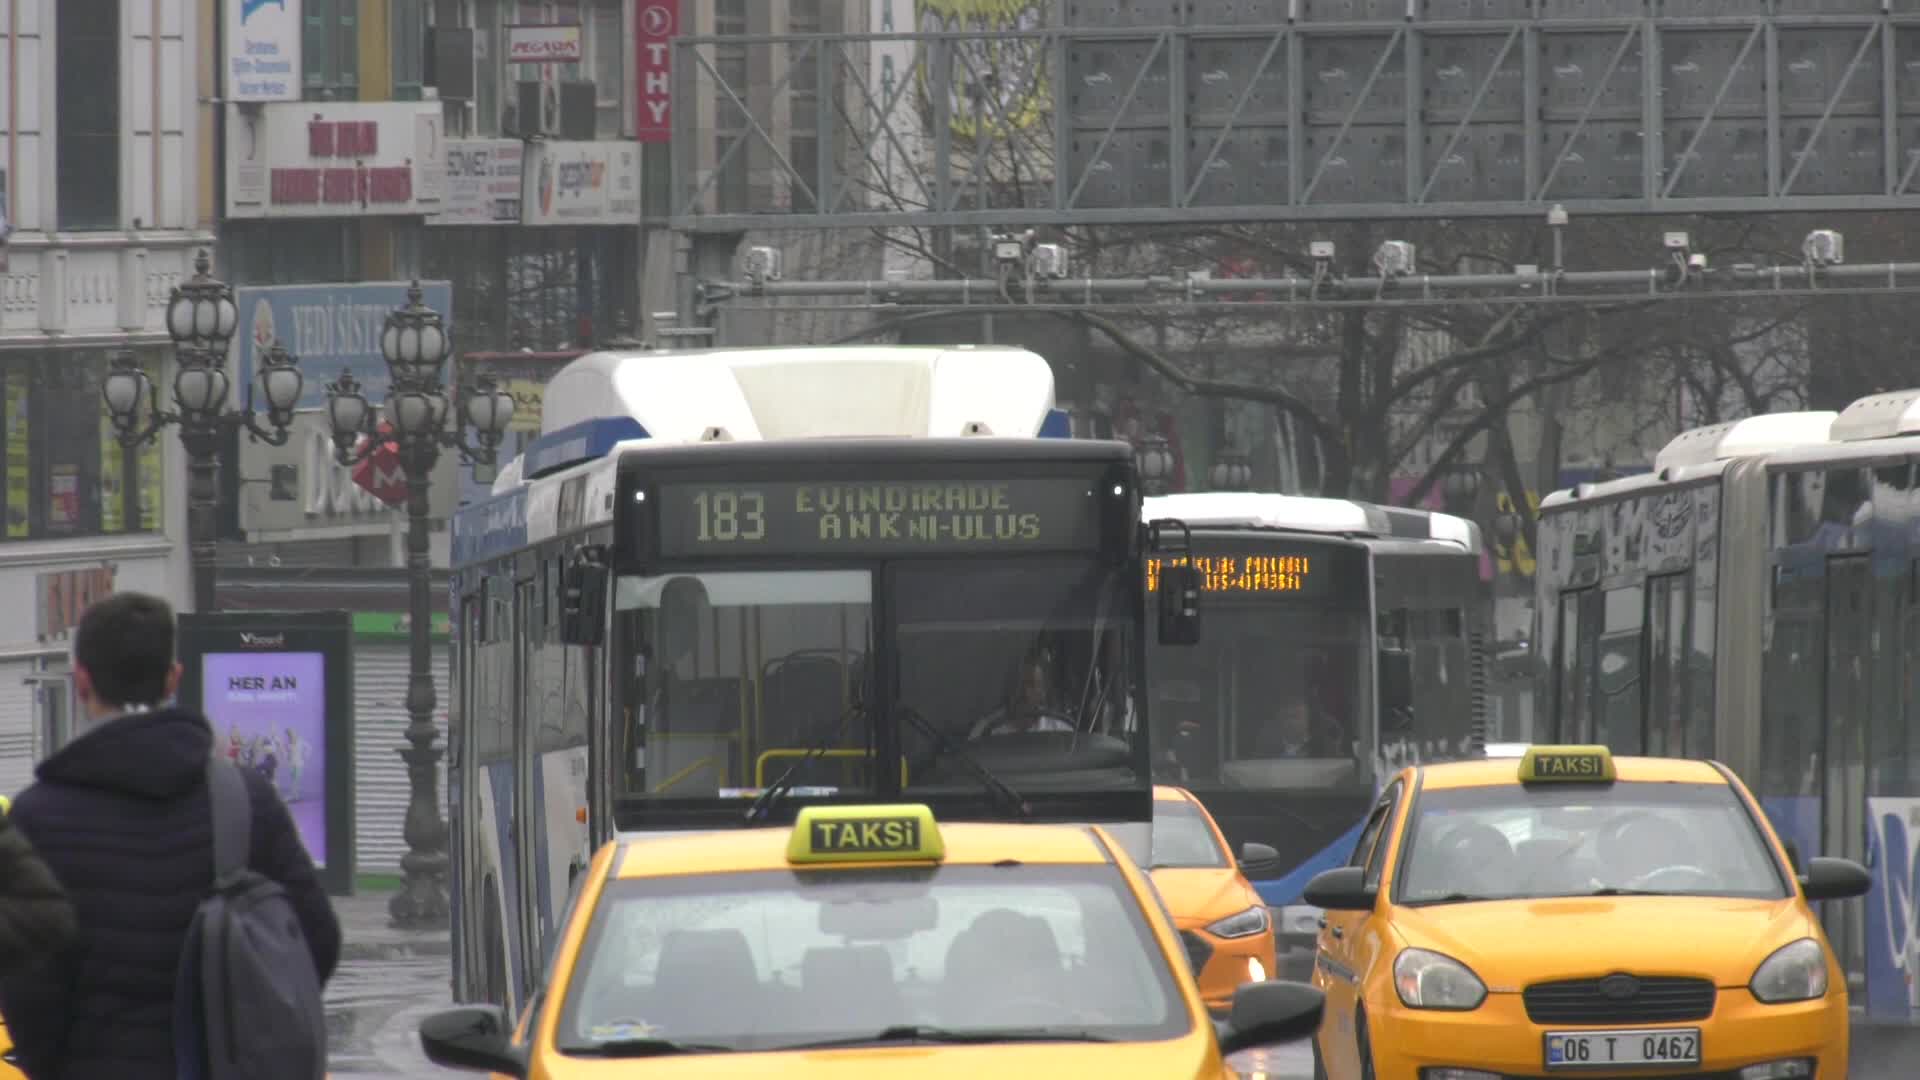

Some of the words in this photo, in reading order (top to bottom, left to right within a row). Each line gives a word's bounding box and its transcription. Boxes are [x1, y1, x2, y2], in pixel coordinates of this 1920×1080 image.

[646, 42, 669, 124] THY
[693, 491, 766, 542] 183
[228, 676, 265, 690] HER
[271, 676, 297, 690] AN
[1564, 1038, 1590, 1062] 06
[1605, 1037, 1617, 1061] T
[1643, 1035, 1695, 1061] 0462
